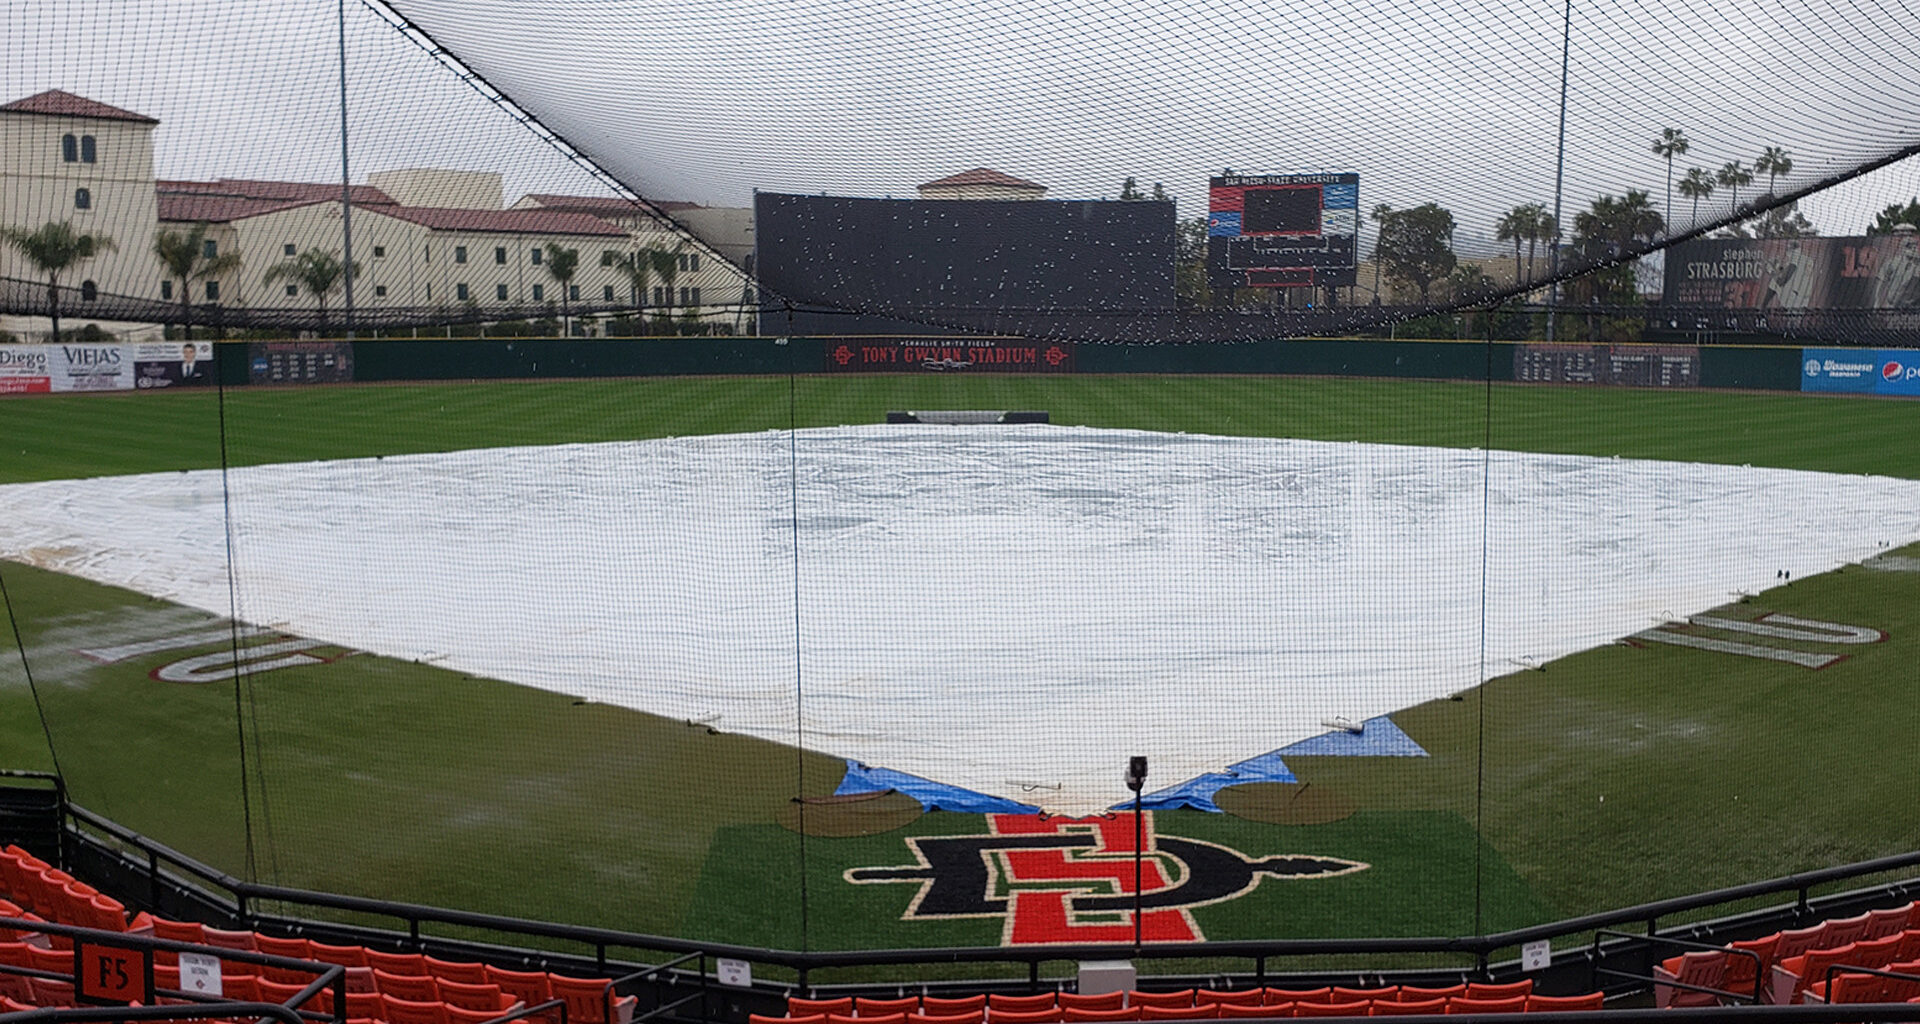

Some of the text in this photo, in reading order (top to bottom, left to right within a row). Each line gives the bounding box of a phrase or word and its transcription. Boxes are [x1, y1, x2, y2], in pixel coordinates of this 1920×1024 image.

[1687, 262, 1763, 279] STRASBURG
[1841, 246, 1877, 278] 19
[0, 349, 46, 369] Diego
[63, 346, 121, 367] VIEJAS
[862, 347, 899, 363] TONY
[903, 347, 961, 364] GWYNN
[967, 347, 1036, 363] STADIUM
[99, 955, 128, 990] F5
